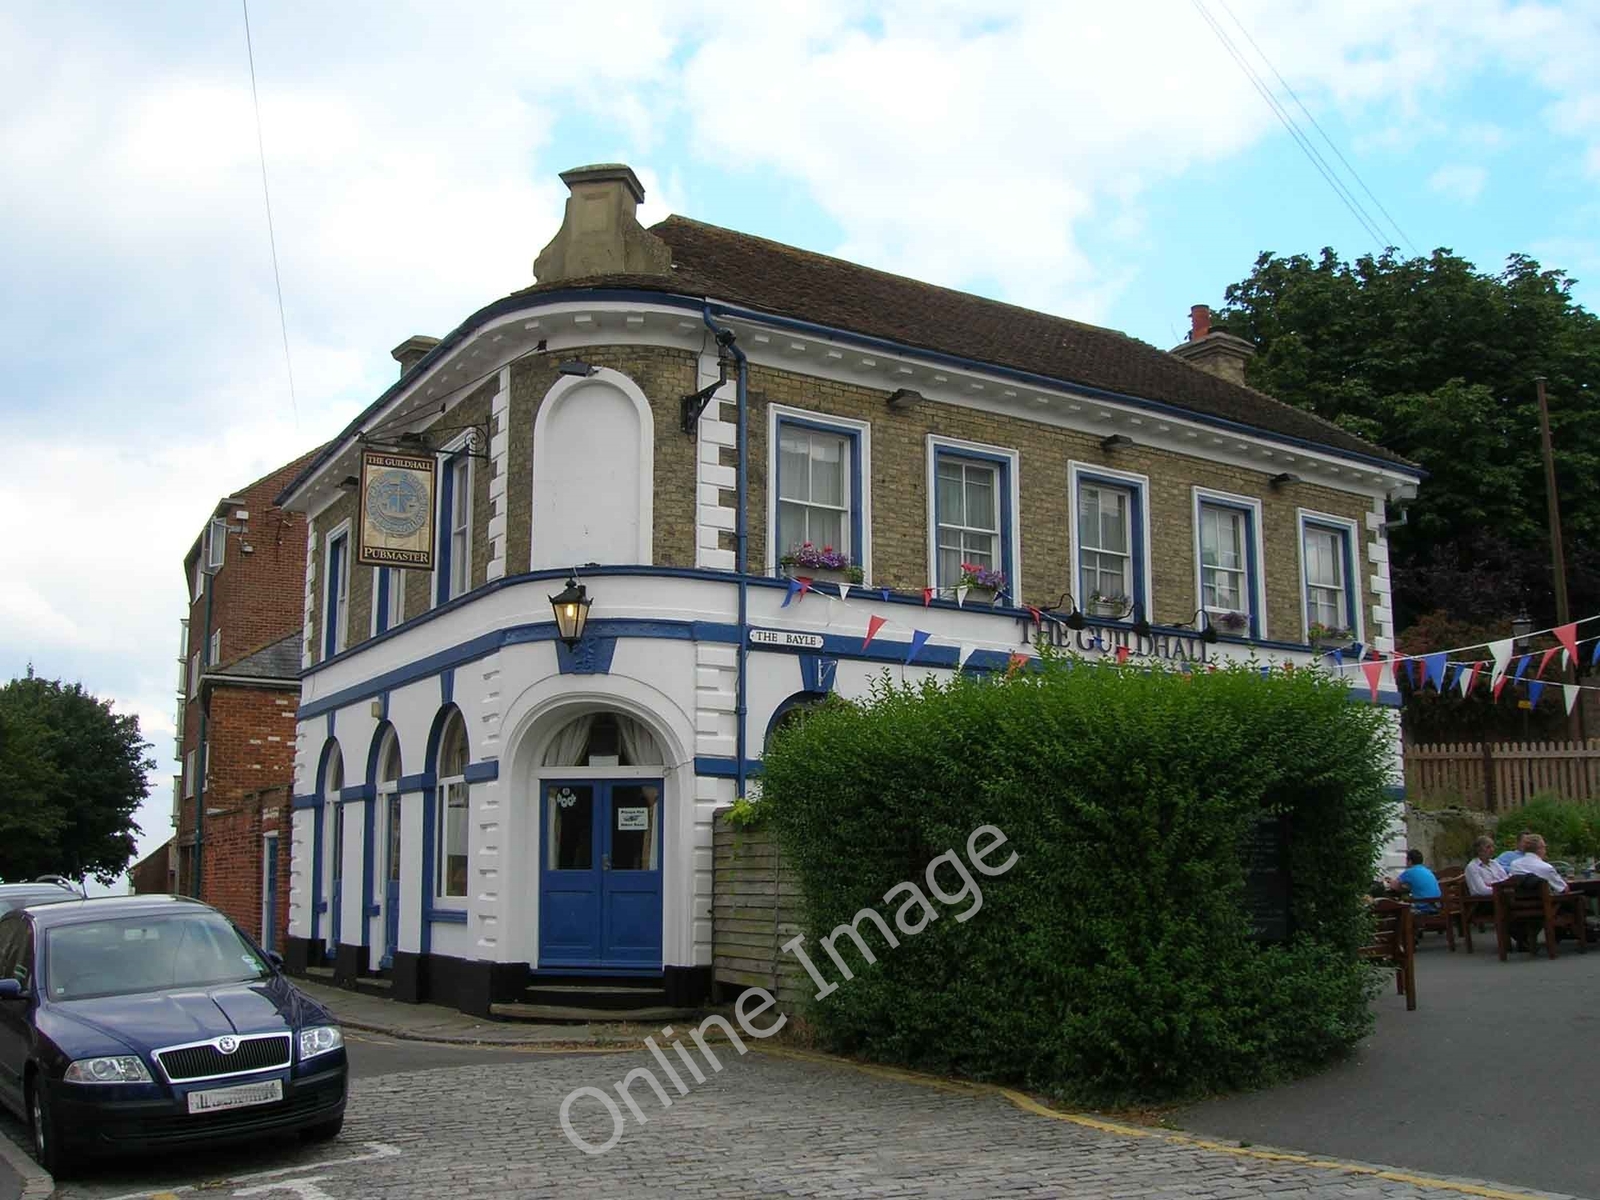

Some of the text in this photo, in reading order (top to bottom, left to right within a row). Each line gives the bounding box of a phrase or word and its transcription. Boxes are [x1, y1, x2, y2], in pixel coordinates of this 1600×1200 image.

[368, 457, 431, 470] THE GUILDHALL
[364, 547, 429, 563] PUBMASTER
[756, 631, 816, 646] THE BAYLE
